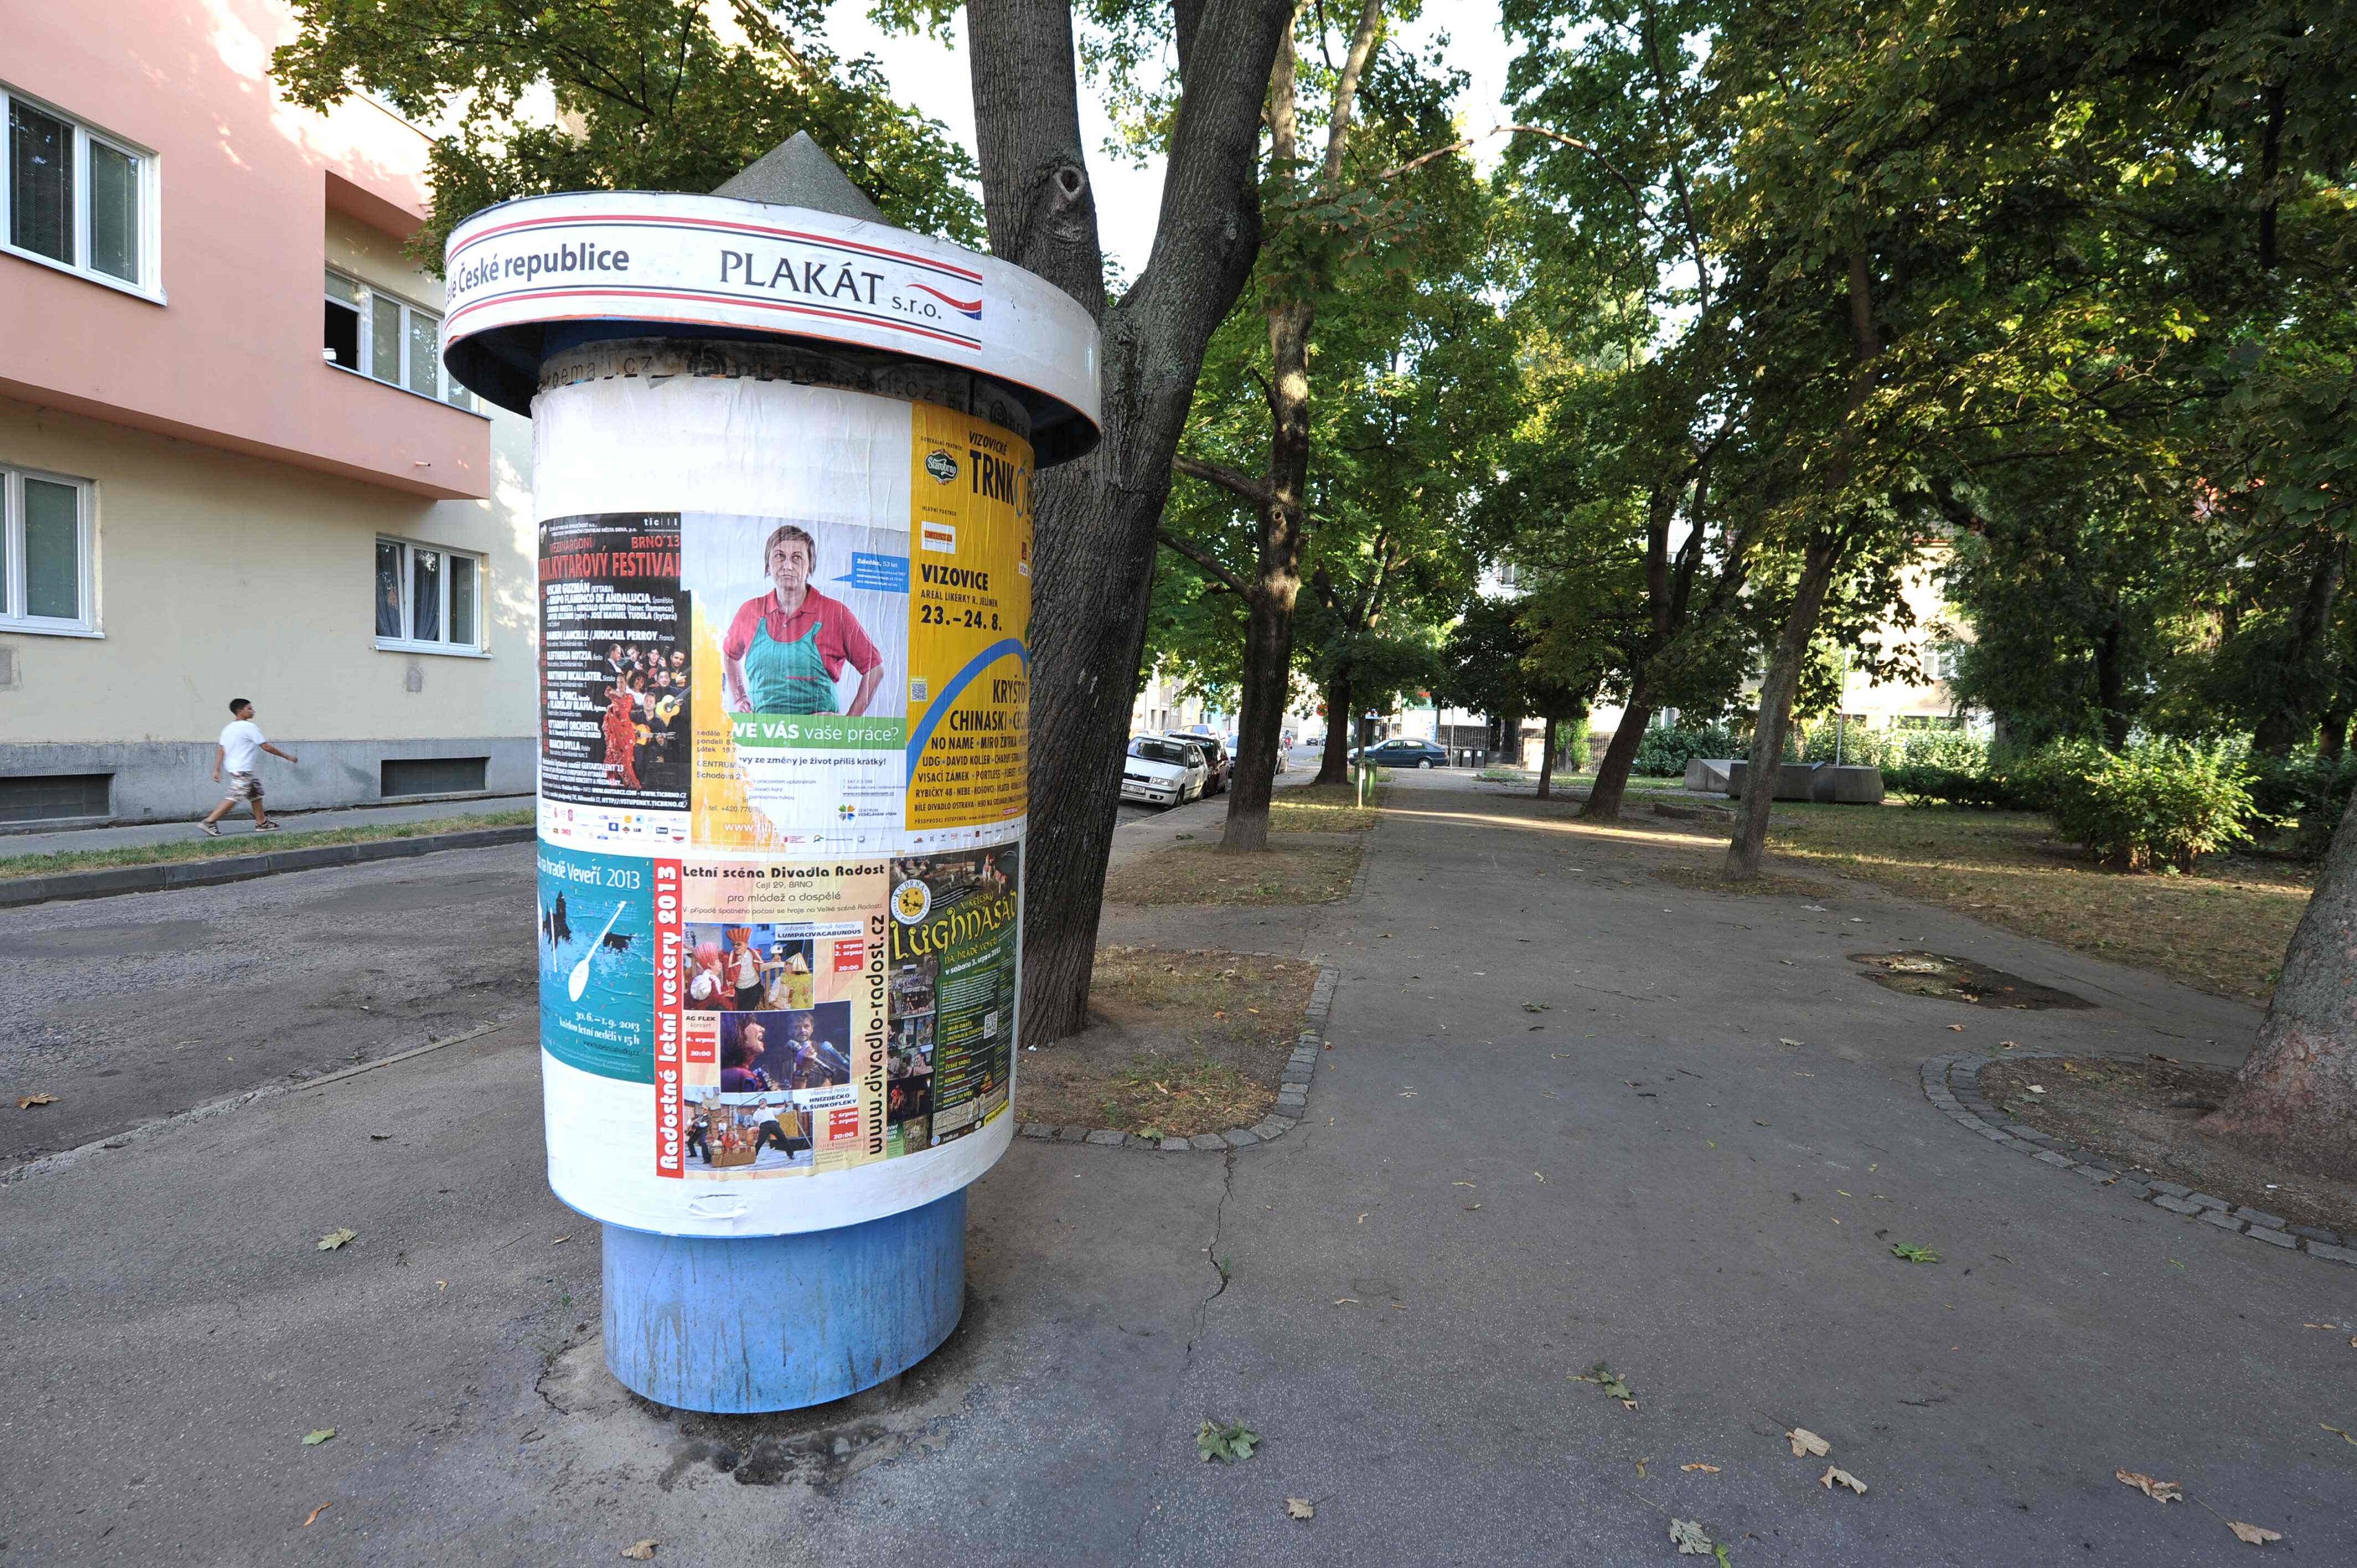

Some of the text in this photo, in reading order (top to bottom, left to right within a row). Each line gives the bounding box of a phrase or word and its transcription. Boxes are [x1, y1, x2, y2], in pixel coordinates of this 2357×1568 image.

[446, 243, 630, 306] elé České republice
[720, 249, 942, 320] PLAKÁT s.r.o.
[969, 431, 1008, 456] VIZOVICKÉ
[928, 457, 957, 476] Starobrno
[552, 545, 608, 580] KYTAROVÝ
[920, 563, 989, 591] VIZOVICE
[595, 594, 605, 603] DE
[605, 593, 651, 604] ANDALUCIA
[920, 588, 943, 600] AREÁL
[945, 589, 970, 604] LIKÉRKY
[979, 594, 998, 608] JELÍNEK
[628, 612, 652, 620] TUDELA
[653, 613, 677, 621] (kytara)
[950, 710, 1007, 731] CHINASKI
[762, 718, 800, 739] VÁS
[804, 726, 842, 740] vaše
[847, 726, 899, 743] práce?
[931, 736, 999, 750] NO NAME MIRO
[767, 756, 797, 767] změny
[799, 757, 807, 766] je
[810, 756, 832, 765] život
[834, 756, 855, 767] příliš
[857, 757, 886, 767] krátký!
[922, 755, 991, 767] UDG DAVID KOLLER
[918, 770, 943, 783] VISACÍ
[946, 769, 969, 782] ZÁMEK
[916, 786, 943, 798] RYBIČKY
[945, 788, 953, 796] 48
[956, 786, 971, 796] NEBE
[914, 804, 926, 812] BÍLÉ
[927, 803, 951, 811] DIVADLO
[952, 801, 974, 809] OSTRAVA
[567, 863, 602, 886] Veveří
[606, 868, 640, 889] 2013
[682, 865, 885, 878] Letní scéna Divadla Radost
[755, 881, 813, 890] Cejl 29, BRNO
[894, 881, 924, 898] KUDRNA
[728, 896, 744, 904] pro
[747, 893, 785, 902] mládež
[799, 891, 841, 903] dospělé
[777, 929, 862, 938] LUMPACIVAGABUNDUS
[842, 943, 863, 951] srpna
[842, 950, 863, 958] srpna
[950, 961, 971, 974] sobotu
[657, 866, 682, 1170] Radostné letní večery 2013
[578, 1023, 594, 1036] letní
[594, 1028, 617, 1042] neděli
[619, 1021, 640, 1033] 2013
[865, 915, 885, 1155] www.divadlo-radost.cz
[809, 1094, 850, 1103] HNÍZDEČKO
[838, 1110, 858, 1118] srpna
[833, 1131, 854, 1139] 20:00
